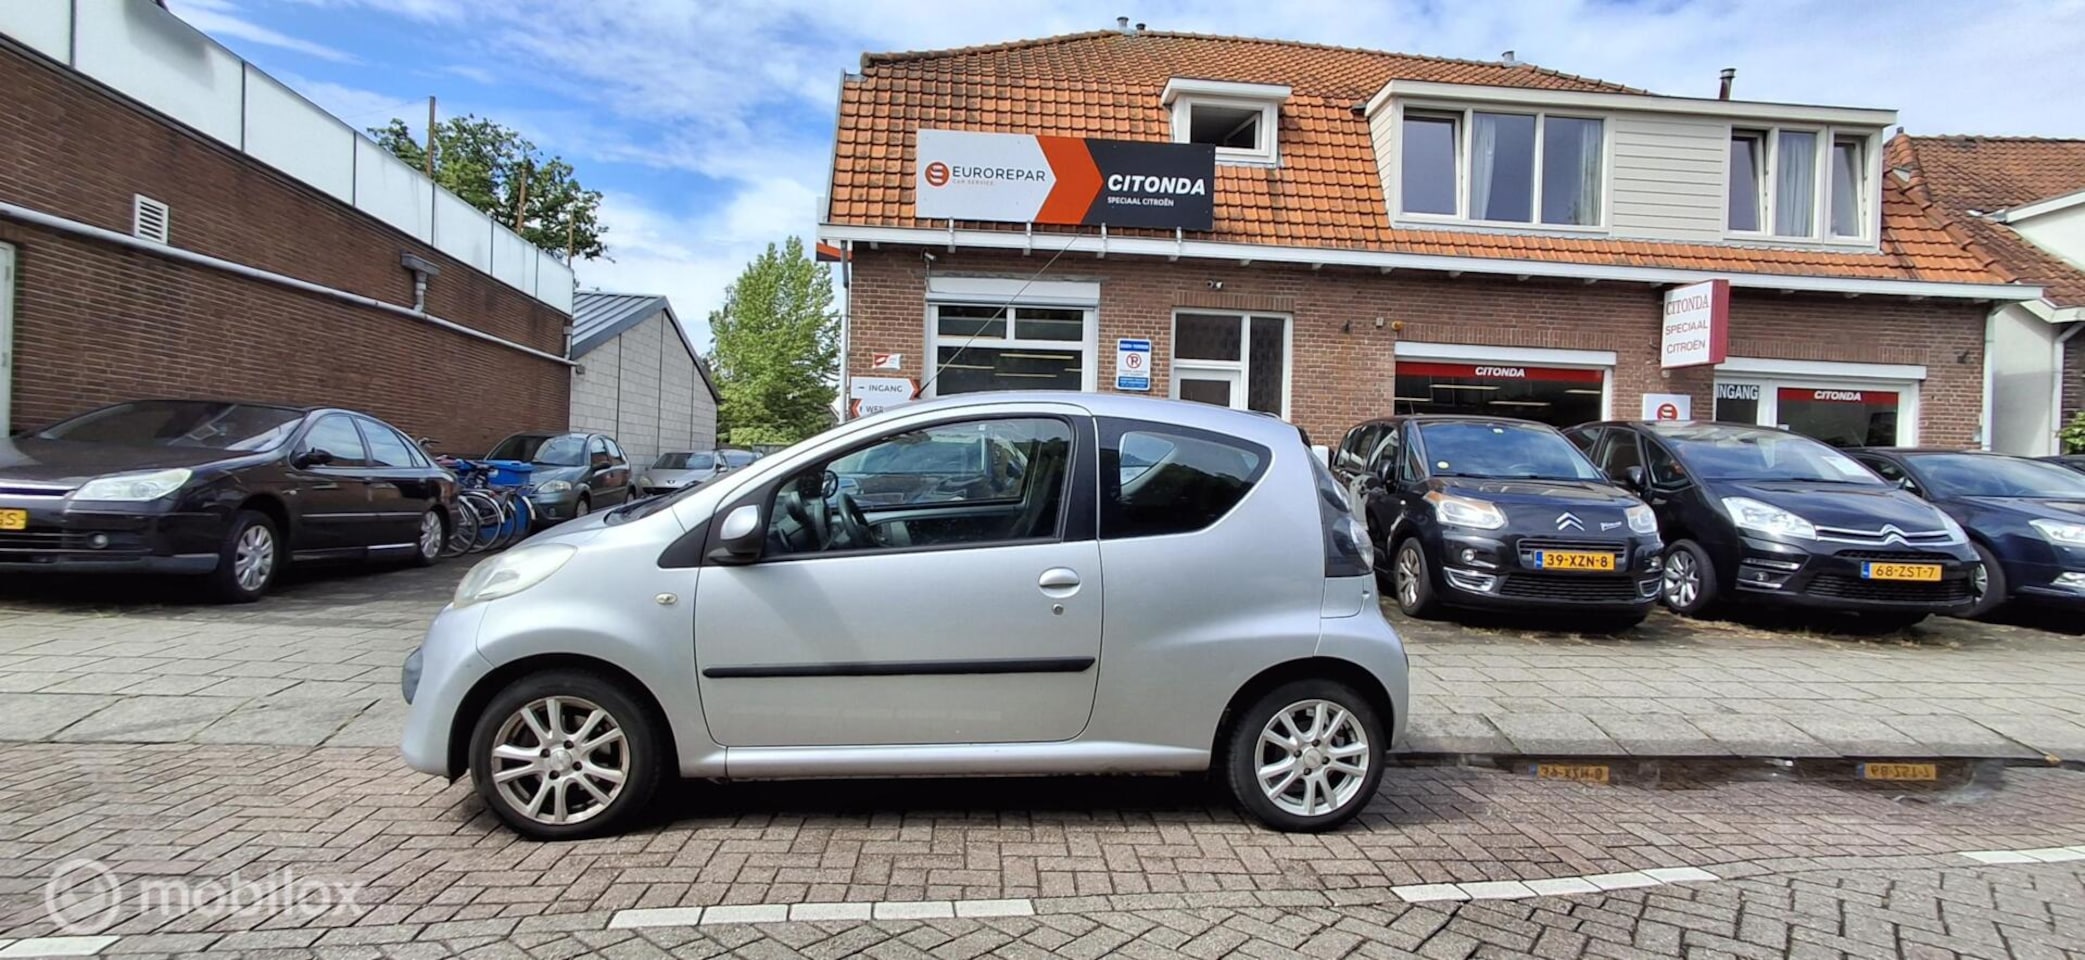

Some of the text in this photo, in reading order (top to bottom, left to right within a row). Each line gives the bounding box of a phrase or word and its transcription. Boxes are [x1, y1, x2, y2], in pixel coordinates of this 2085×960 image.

[952, 166, 1046, 181] EUROREPAR
[1107, 174, 1205, 195] CITONDA
[1107, 196, 1174, 207] SPECIAAL CITROËN
[1666, 295, 1709, 315] CITONDA
[1665, 320, 1708, 335] SPECIAAL
[1475, 366, 1525, 377] CITONDA
[869, 384, 903, 393] INGANG
[1814, 390, 1862, 401] CITONDA
[1547, 554, 1608, 568] 39-XZN-8
[1875, 565, 1936, 579] 68-ZST-7
